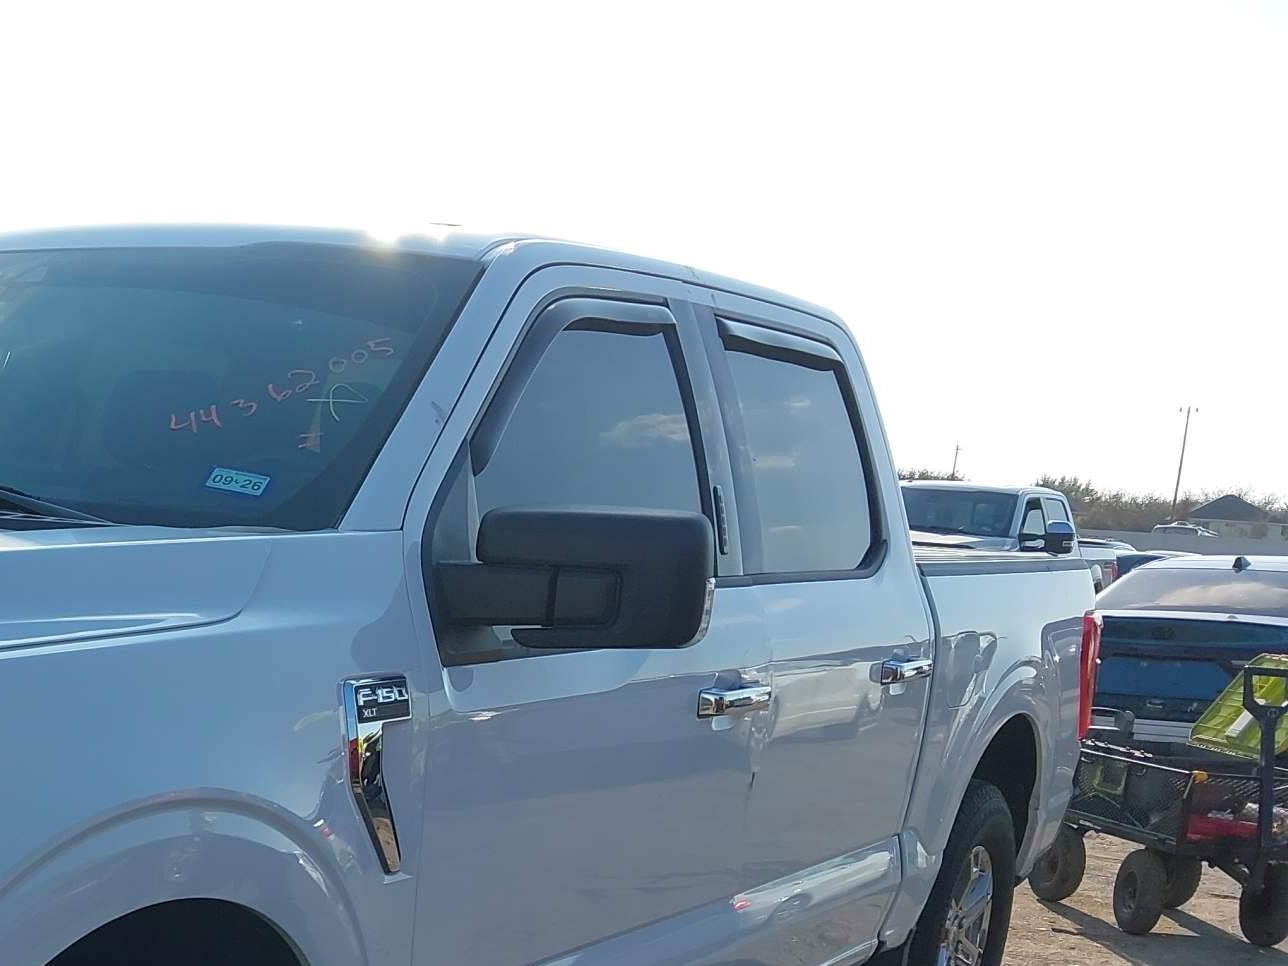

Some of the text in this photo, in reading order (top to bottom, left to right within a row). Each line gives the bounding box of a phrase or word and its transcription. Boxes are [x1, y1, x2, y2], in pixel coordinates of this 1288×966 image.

[170, 337, 394, 432] 44362005
[357, 686, 408, 706] F-150
[362, 707, 377, 718] XLT
